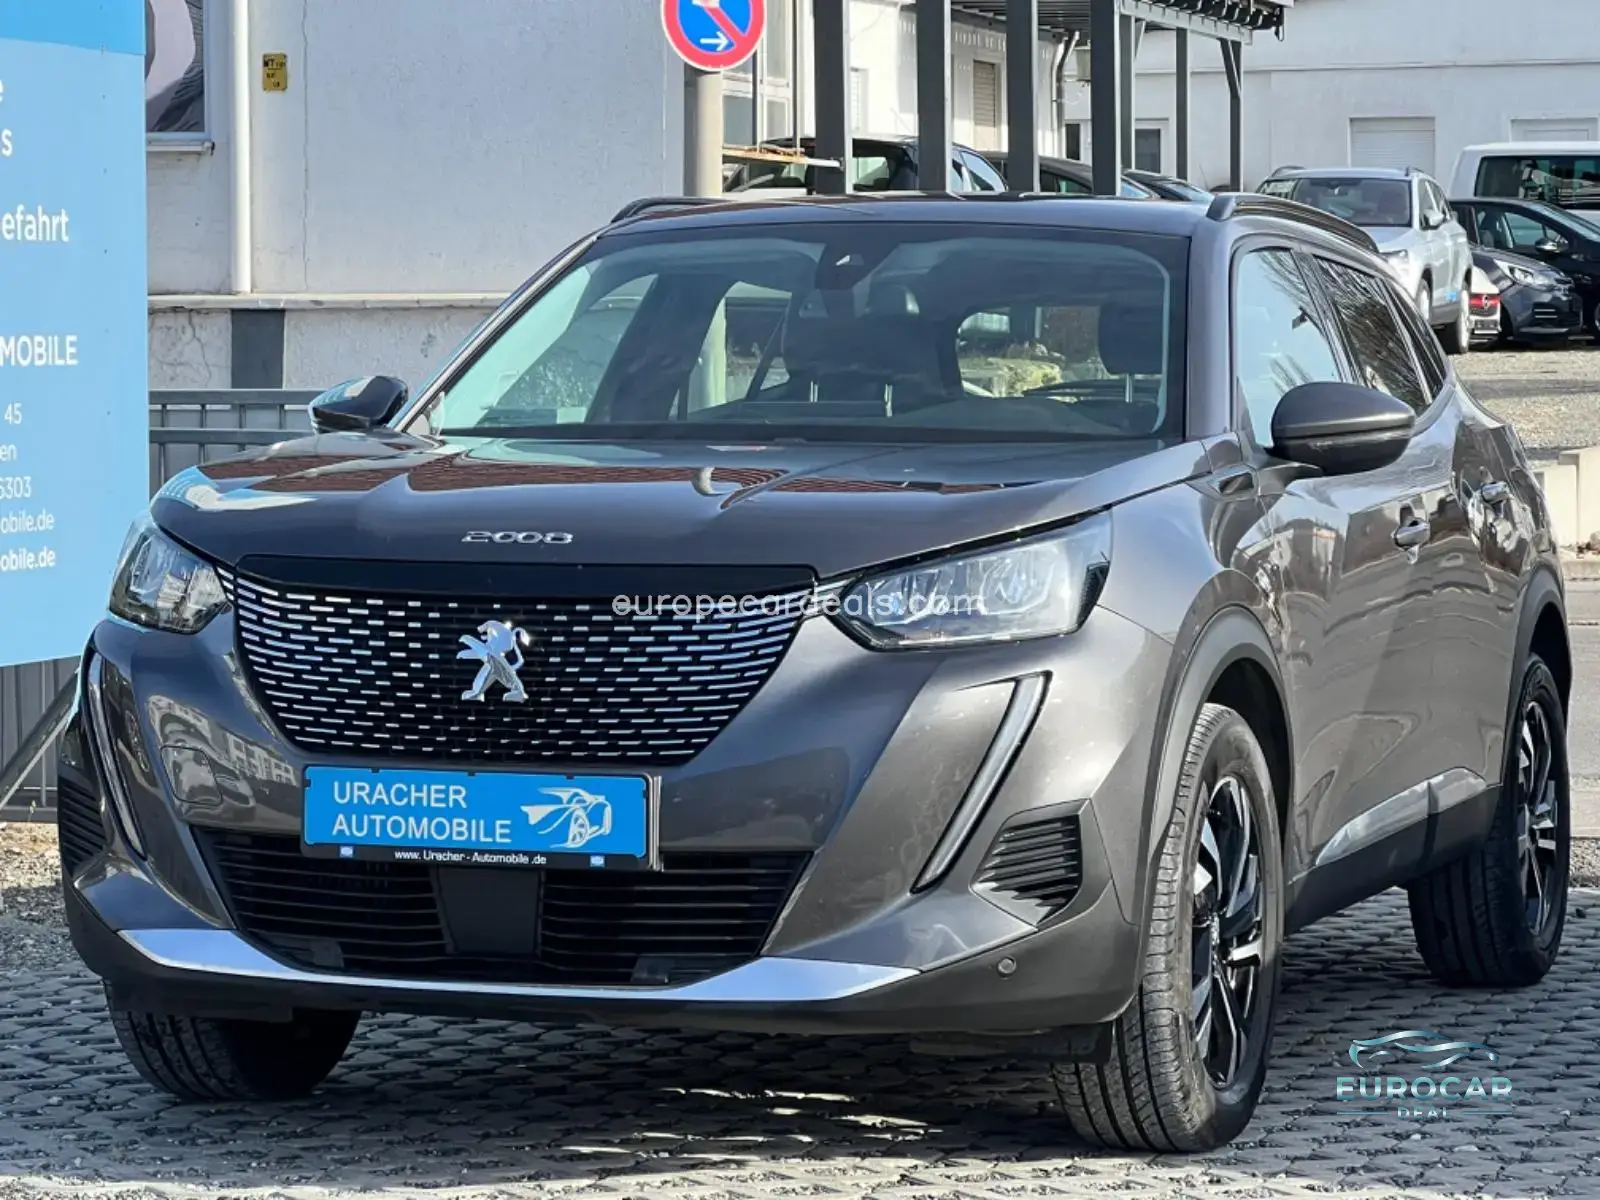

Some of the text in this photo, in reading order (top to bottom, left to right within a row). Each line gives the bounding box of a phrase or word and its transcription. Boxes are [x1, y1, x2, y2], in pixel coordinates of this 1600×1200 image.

[2, 204, 69, 242] efahrt
[0, 335, 78, 367] MOBILE
[4, 402, 22, 425] 45
[461, 531, 574, 544] 2008
[333, 781, 467, 808] URACHER
[332, 814, 512, 843] AUTOMOBILE
